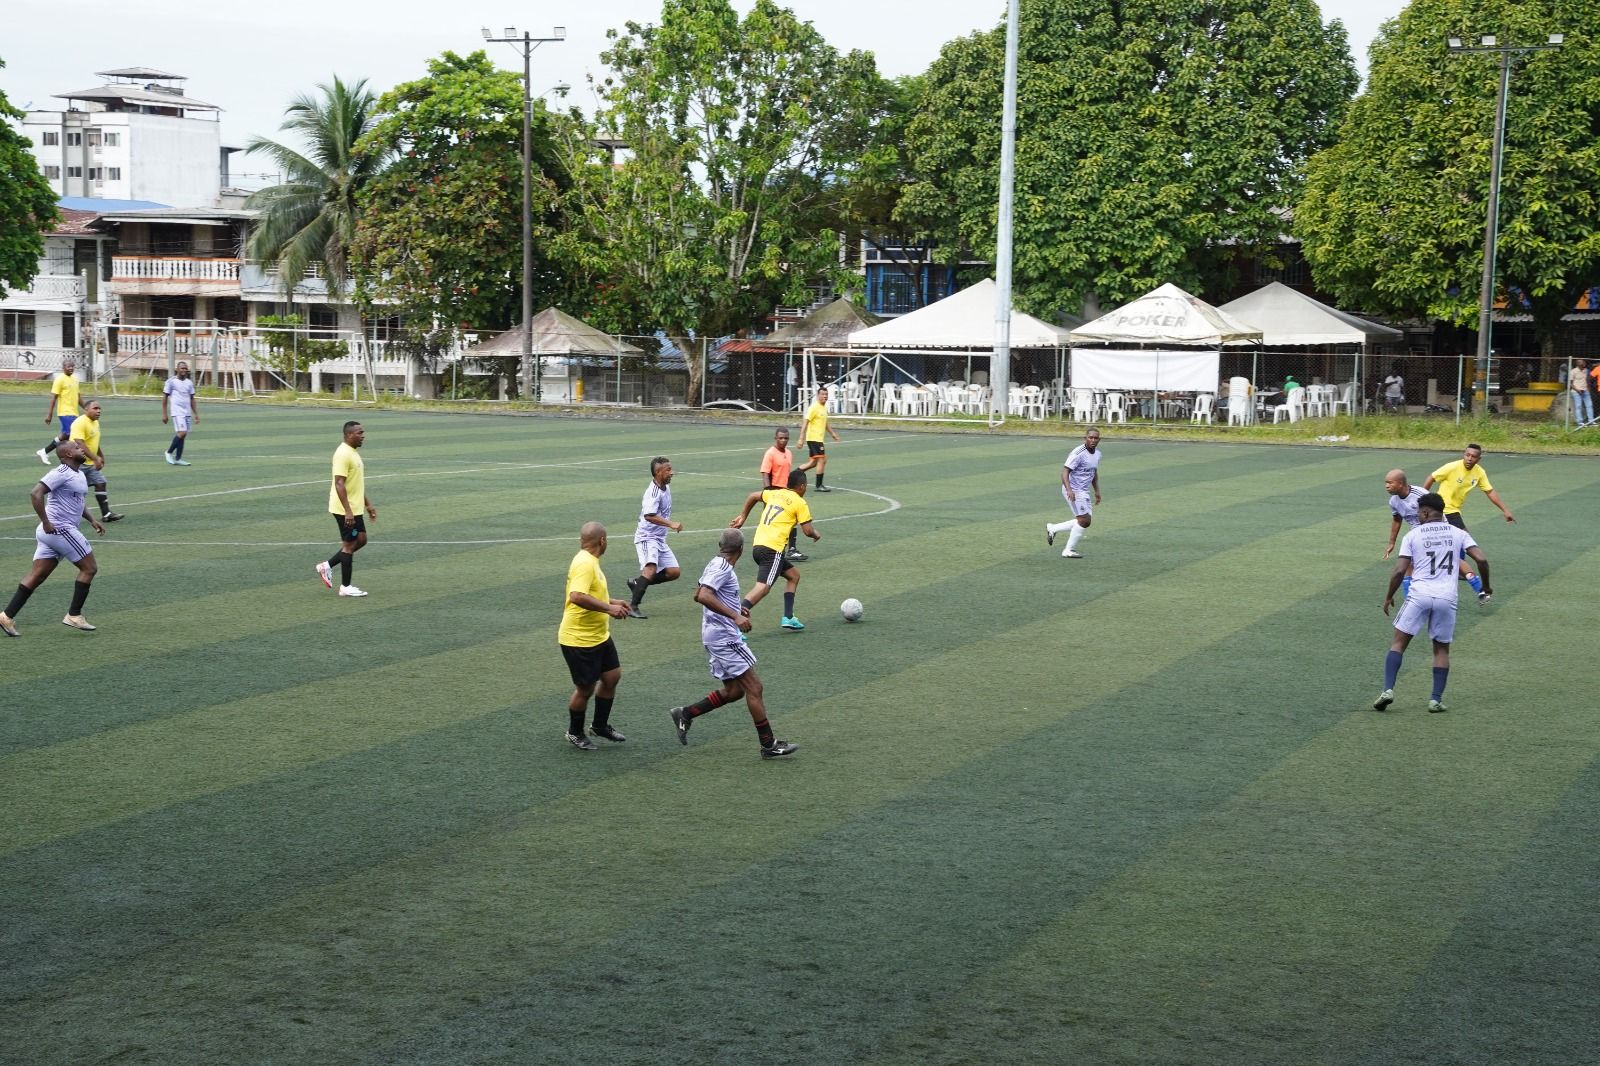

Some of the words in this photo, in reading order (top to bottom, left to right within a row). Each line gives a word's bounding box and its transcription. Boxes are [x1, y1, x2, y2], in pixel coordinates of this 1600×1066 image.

[1117, 314, 1187, 327] POKER
[763, 505, 784, 525] 17
[1426, 551, 1454, 575] 14
